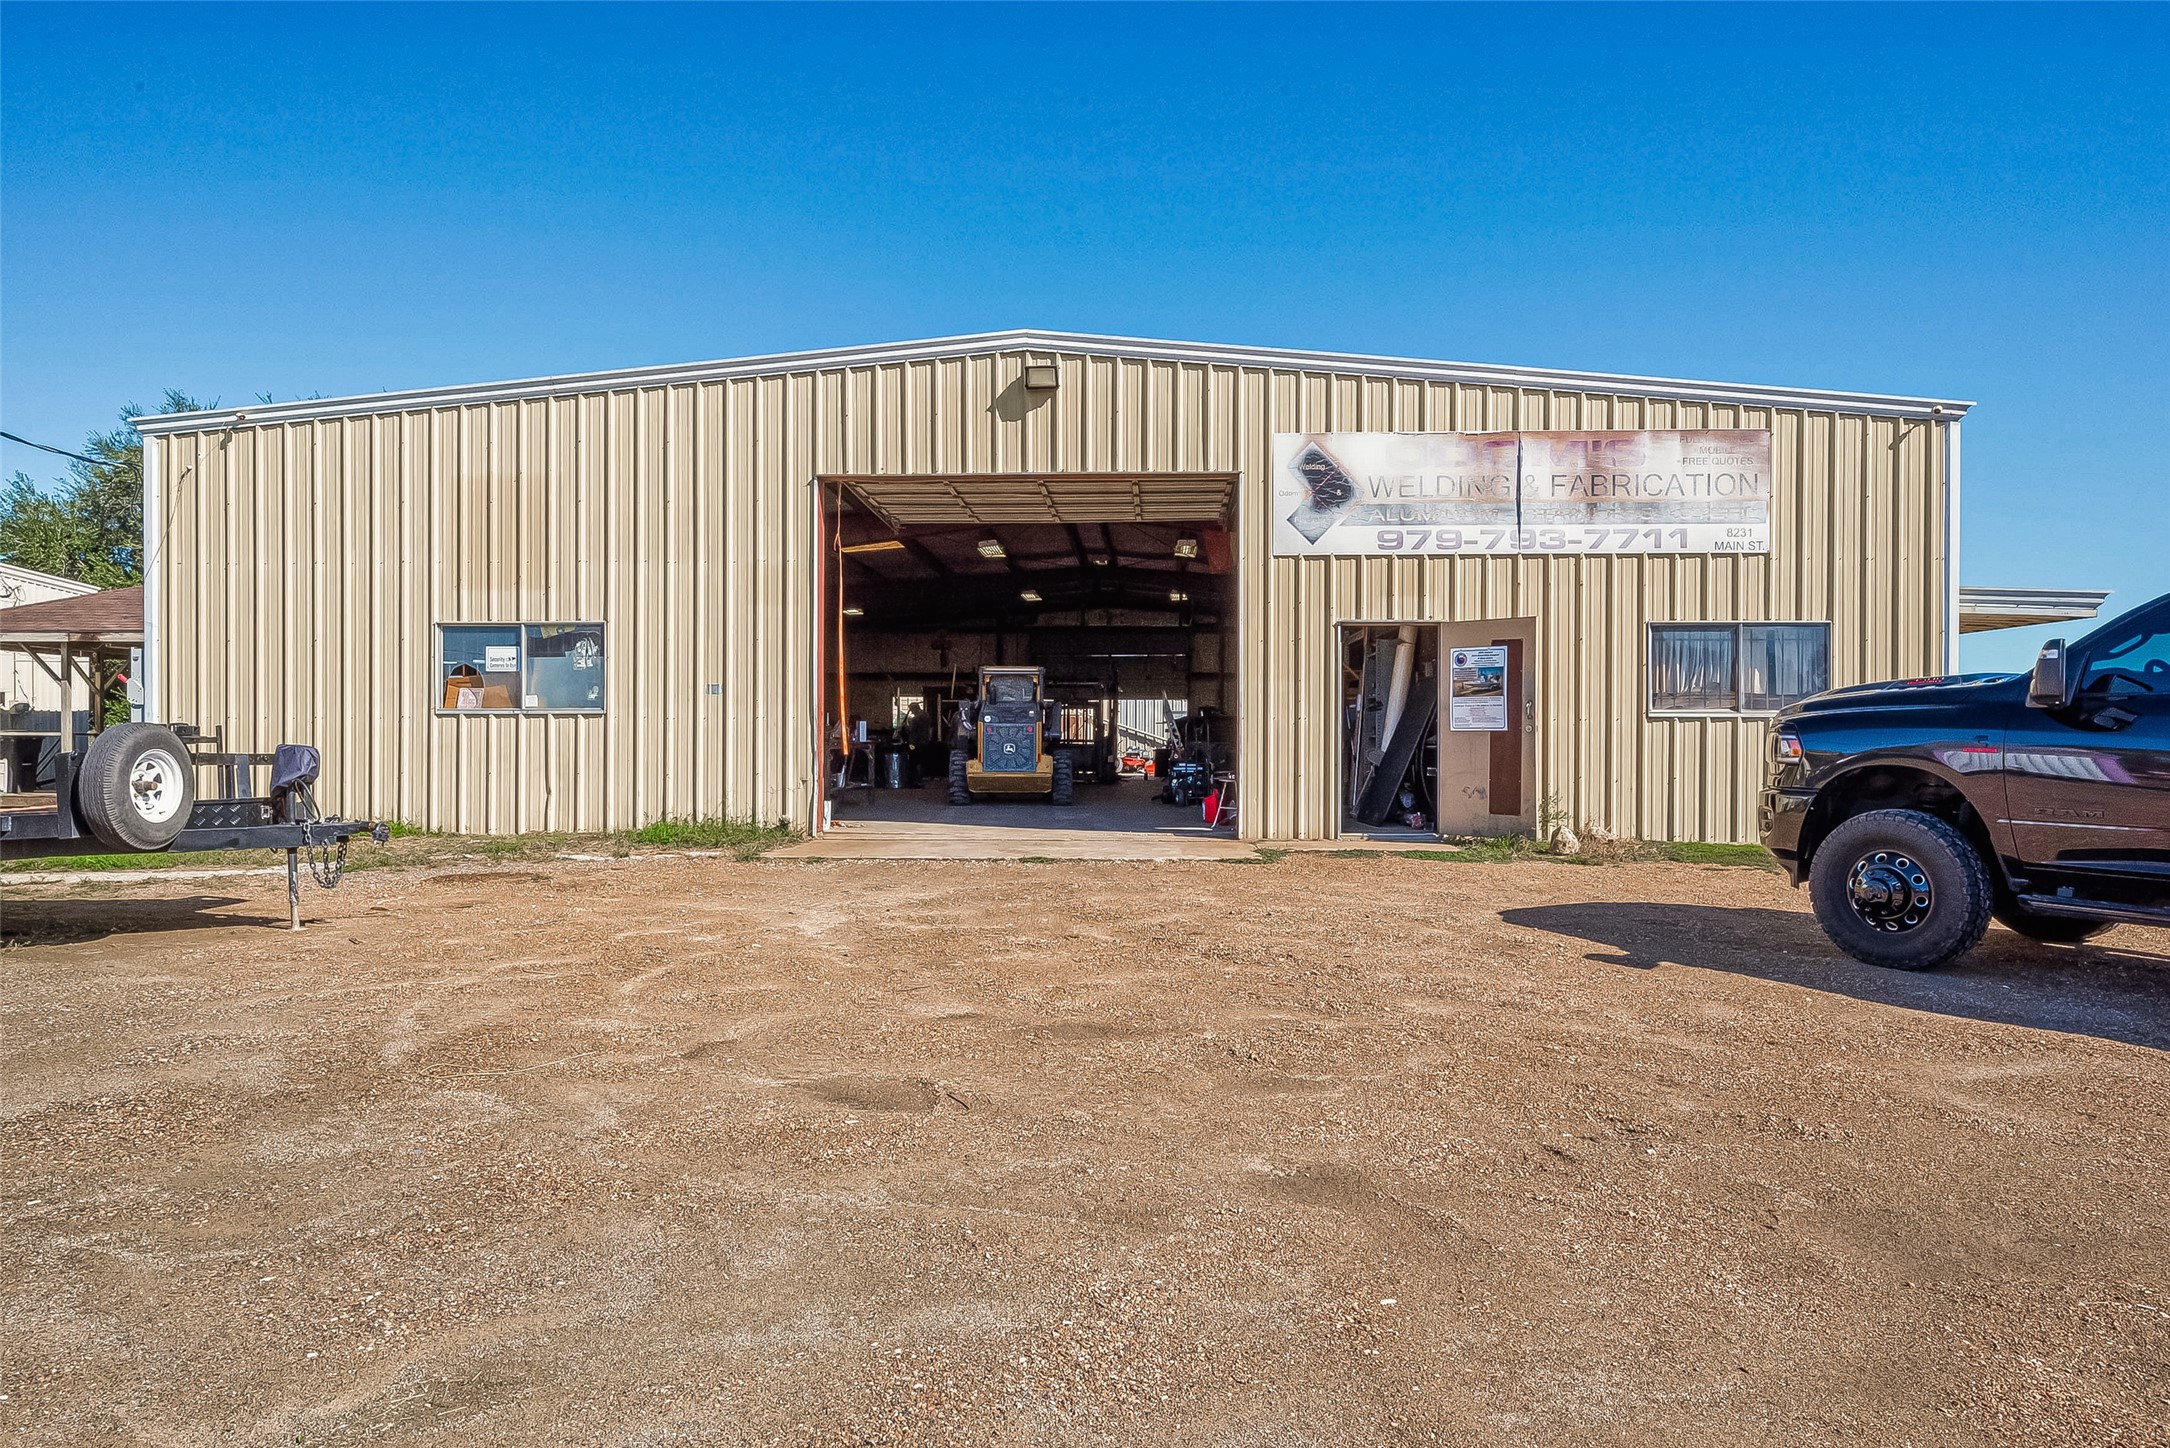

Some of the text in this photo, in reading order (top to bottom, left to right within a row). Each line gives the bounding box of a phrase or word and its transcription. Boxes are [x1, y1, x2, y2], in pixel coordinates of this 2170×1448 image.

[1699, 446, 1737, 454] MOBILE
[1682, 456, 1754, 465] FREE QUOTES
[1299, 463, 1326, 471] Welding
[1368, 472, 1758, 498] WELDING & FABRICATION
[1726, 528, 1753, 538] 8231
[1377, 528, 1688, 550] 979-793-7711
[1714, 541, 1765, 551] MAIN ST.
